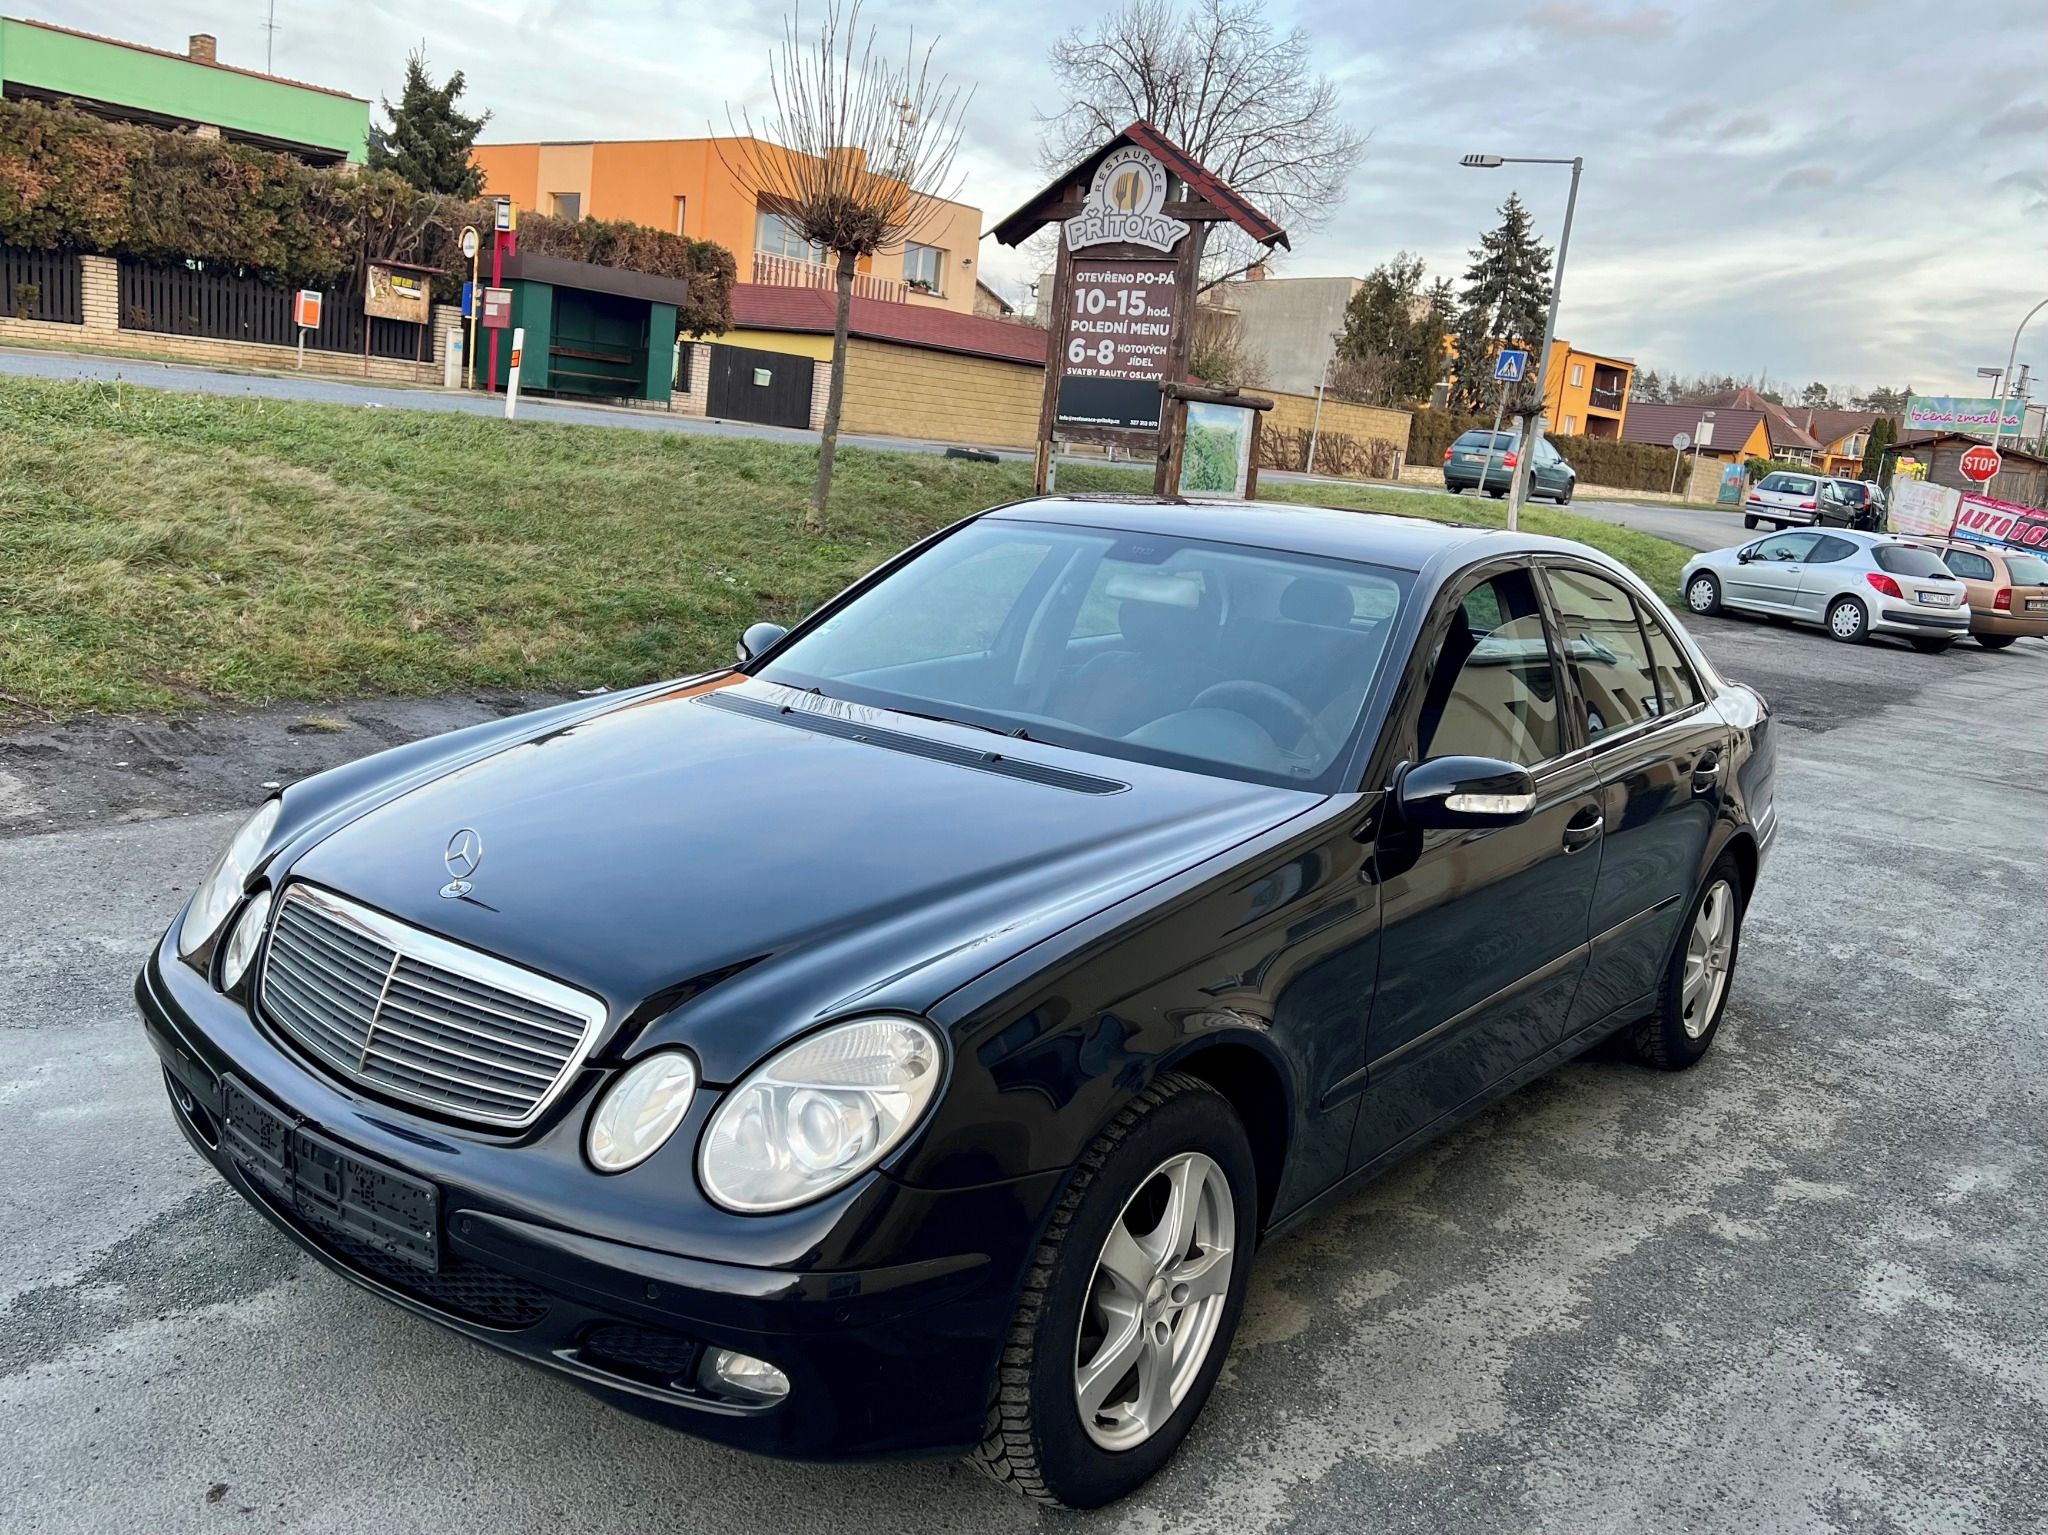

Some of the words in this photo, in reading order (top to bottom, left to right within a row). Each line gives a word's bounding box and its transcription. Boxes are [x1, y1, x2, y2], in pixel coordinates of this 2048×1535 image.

[1095, 151, 1162, 192] RESTAURACE
[1069, 205, 1184, 247] PŘÍTOKY
[1076, 271, 1134, 284] OTEVŘENO
[1136, 270, 1175, 285] PO-PÁ
[1075, 288, 1147, 316] 10-15
[1147, 306, 1171, 317] hod.
[1070, 320, 1129, 334] POLEDNÍ
[1130, 322, 1170, 336] MENU
[1068, 337, 1115, 366] 6-8
[1117, 344, 1167, 355] HOTOVÝCH
[1127, 355, 1154, 367] JÍDEL
[1066, 367, 1098, 376] SVATBY
[1099, 369, 1127, 378] RAUTY
[1129, 371, 1164, 380] OSLAVY
[1910, 404, 1953, 422] točená
[1956, 410, 2019, 426] zmrzlna
[1964, 456, 1998, 472] STOP
